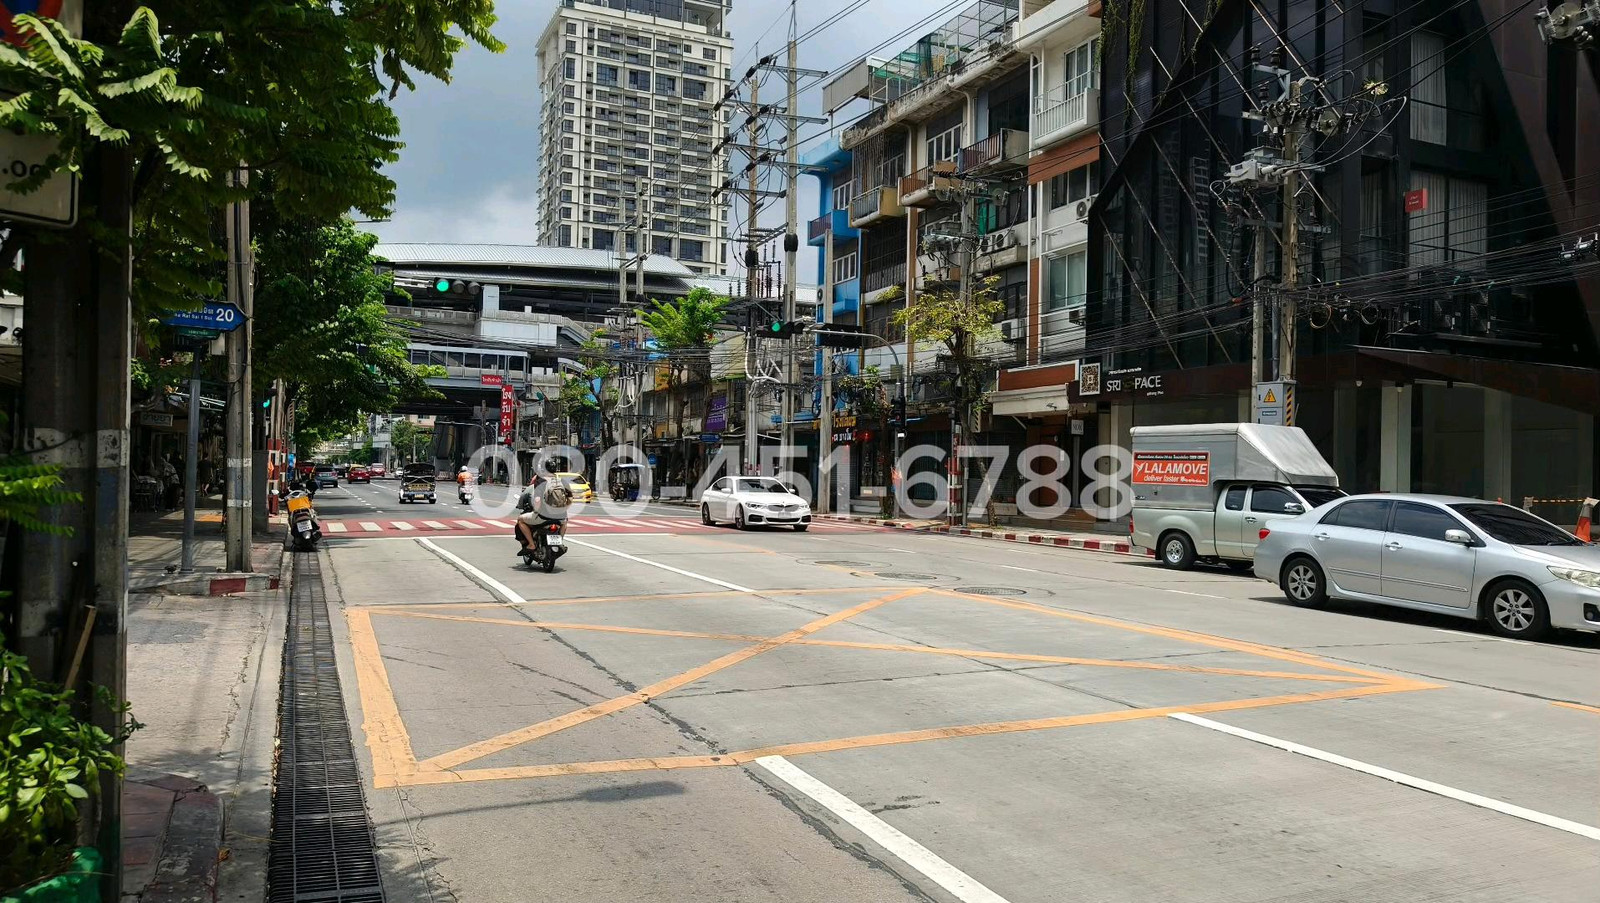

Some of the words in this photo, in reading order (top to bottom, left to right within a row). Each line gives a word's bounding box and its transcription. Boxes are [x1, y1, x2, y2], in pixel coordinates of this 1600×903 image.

[215, 308, 234, 322] 20
[1106, 379, 1121, 392] SRI
[1144, 462, 1208, 475] LALAMOVE
[1143, 474, 1162, 482] deliver
